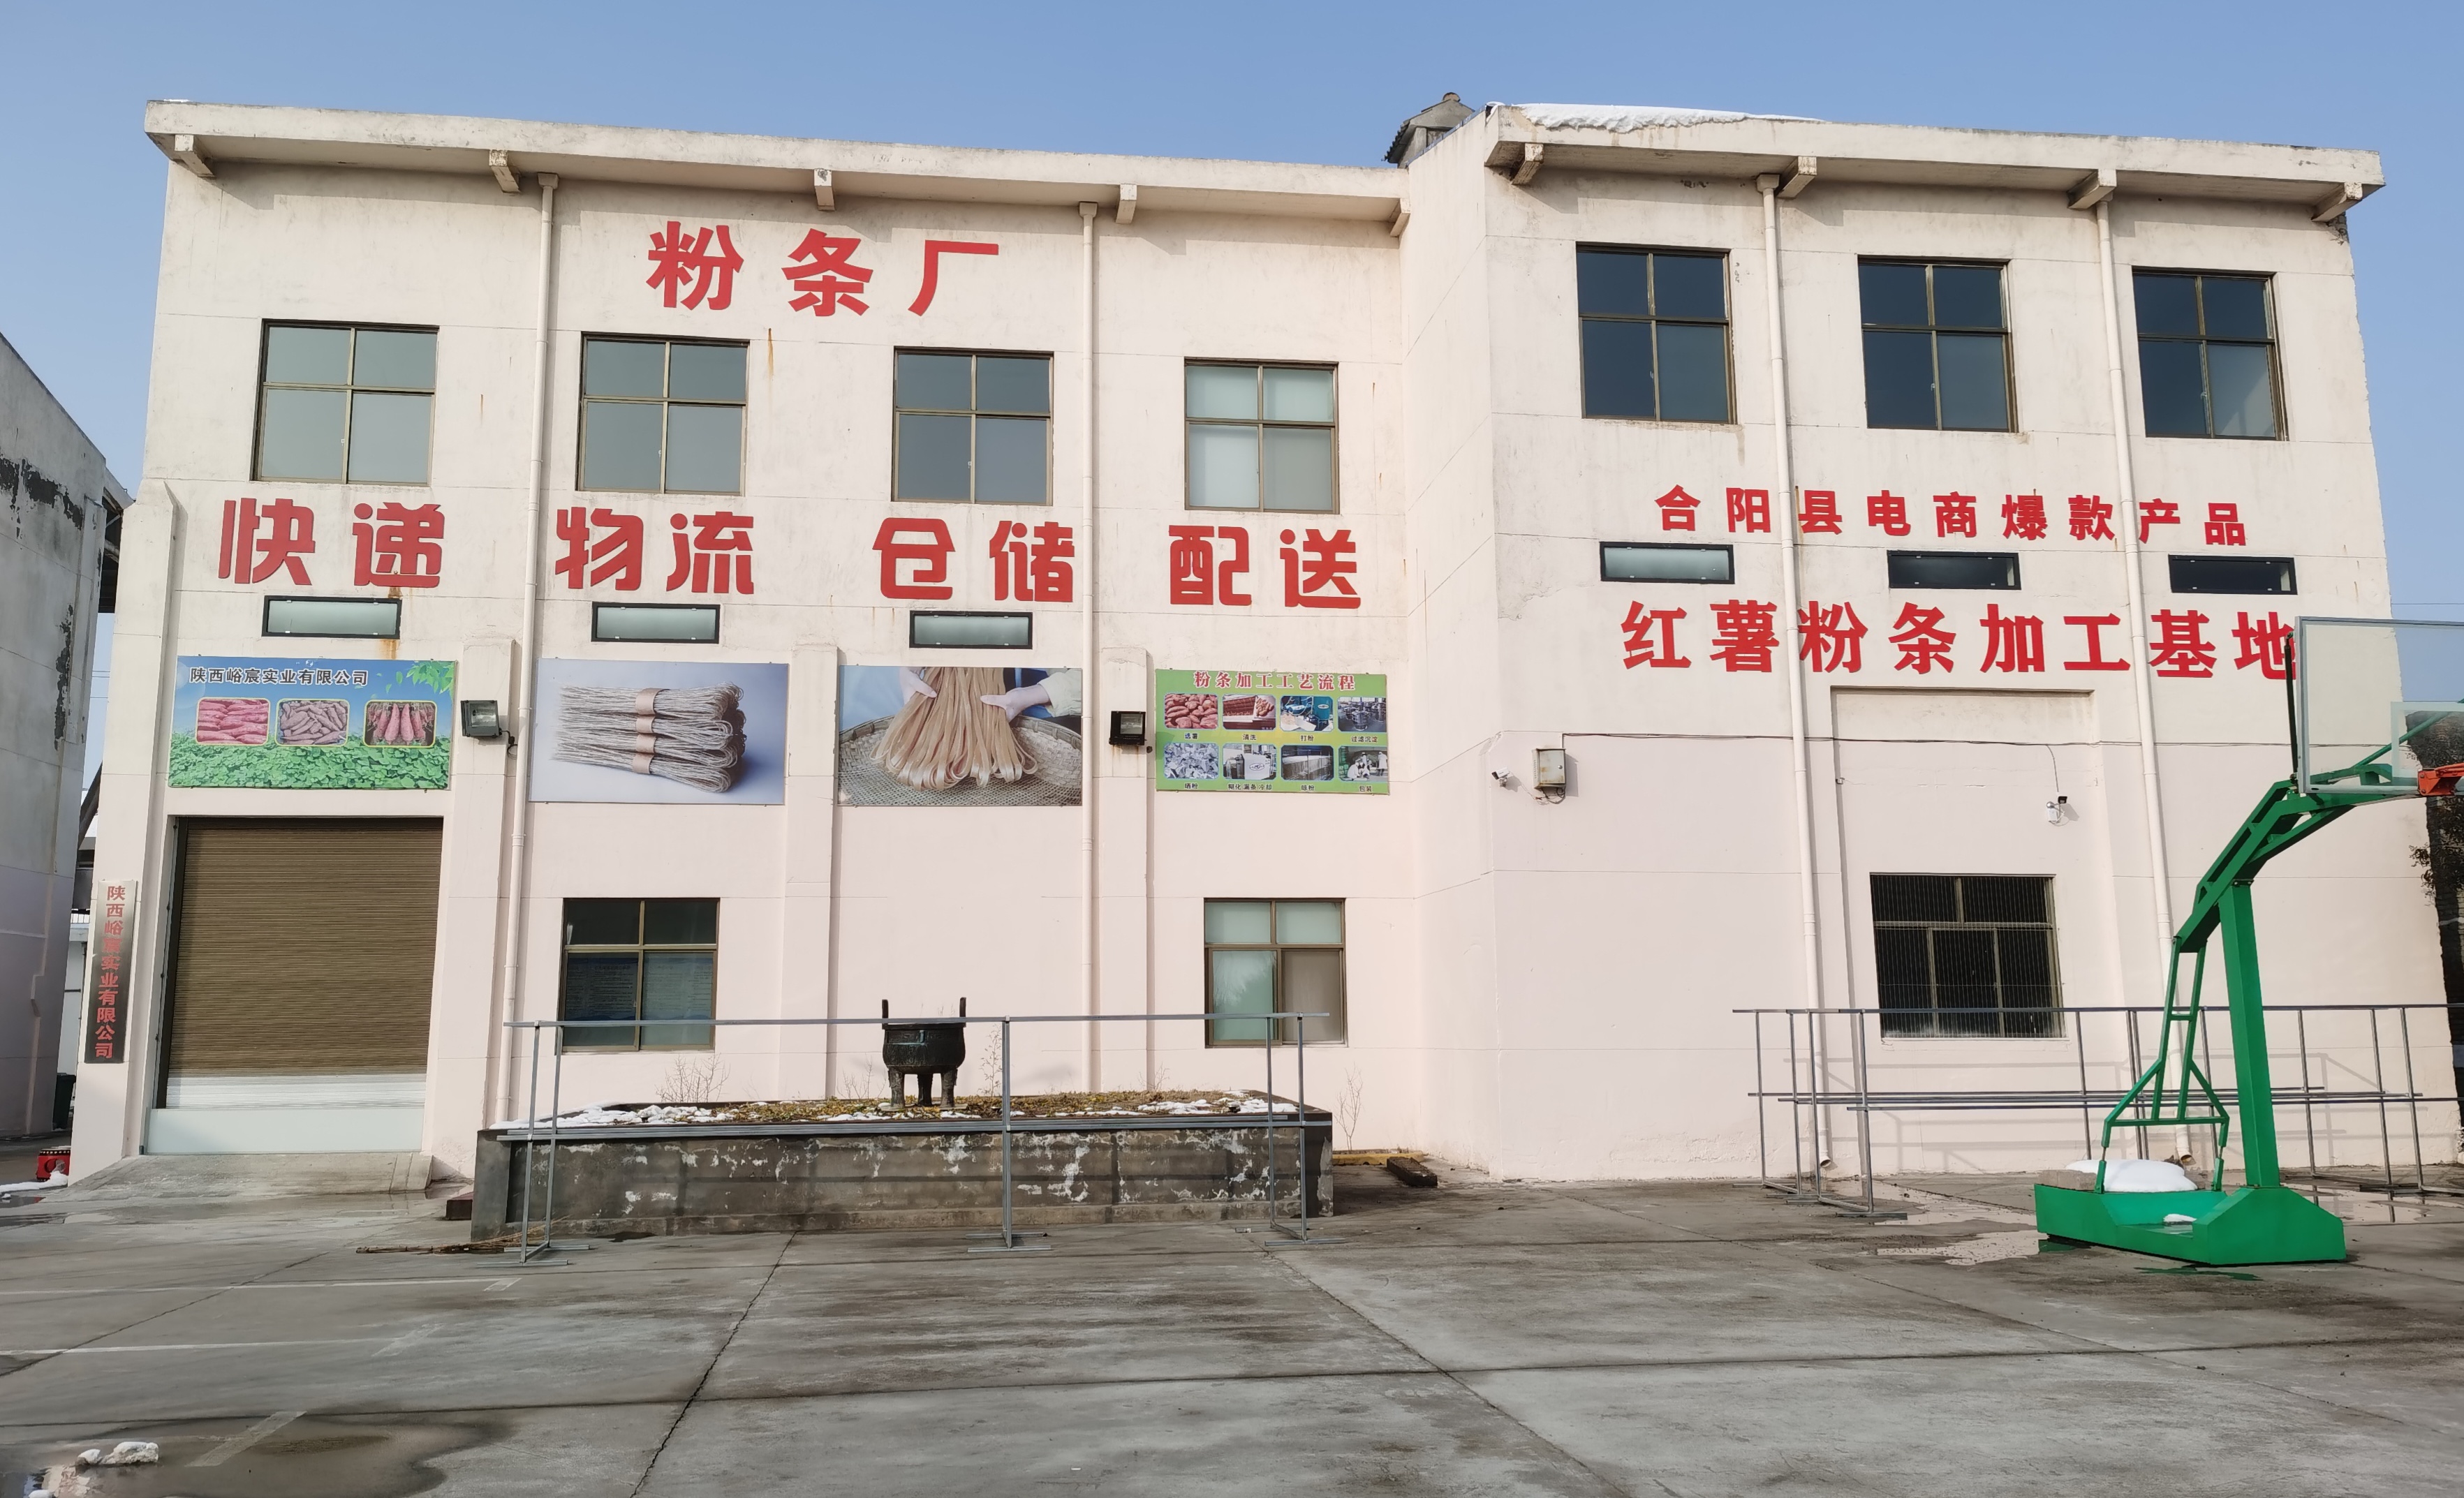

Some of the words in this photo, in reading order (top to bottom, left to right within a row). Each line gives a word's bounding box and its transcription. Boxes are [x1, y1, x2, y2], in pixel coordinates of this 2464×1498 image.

[647, 221, 999, 317] 粉条厂
[1655, 484, 2247, 546] 合阳县电商爆款产品
[219, 498, 445, 588] 快递
[555, 507, 755, 595] 物流
[872, 517, 1075, 602] 仓储
[1169, 525, 1361, 609] 配送
[1621, 599, 2296, 680] 红薯粉条加工基地
[189, 667, 368, 685] 陕西峪宸实业有限公司
[1193, 670, 1356, 691] 粉条加工工艺流程
